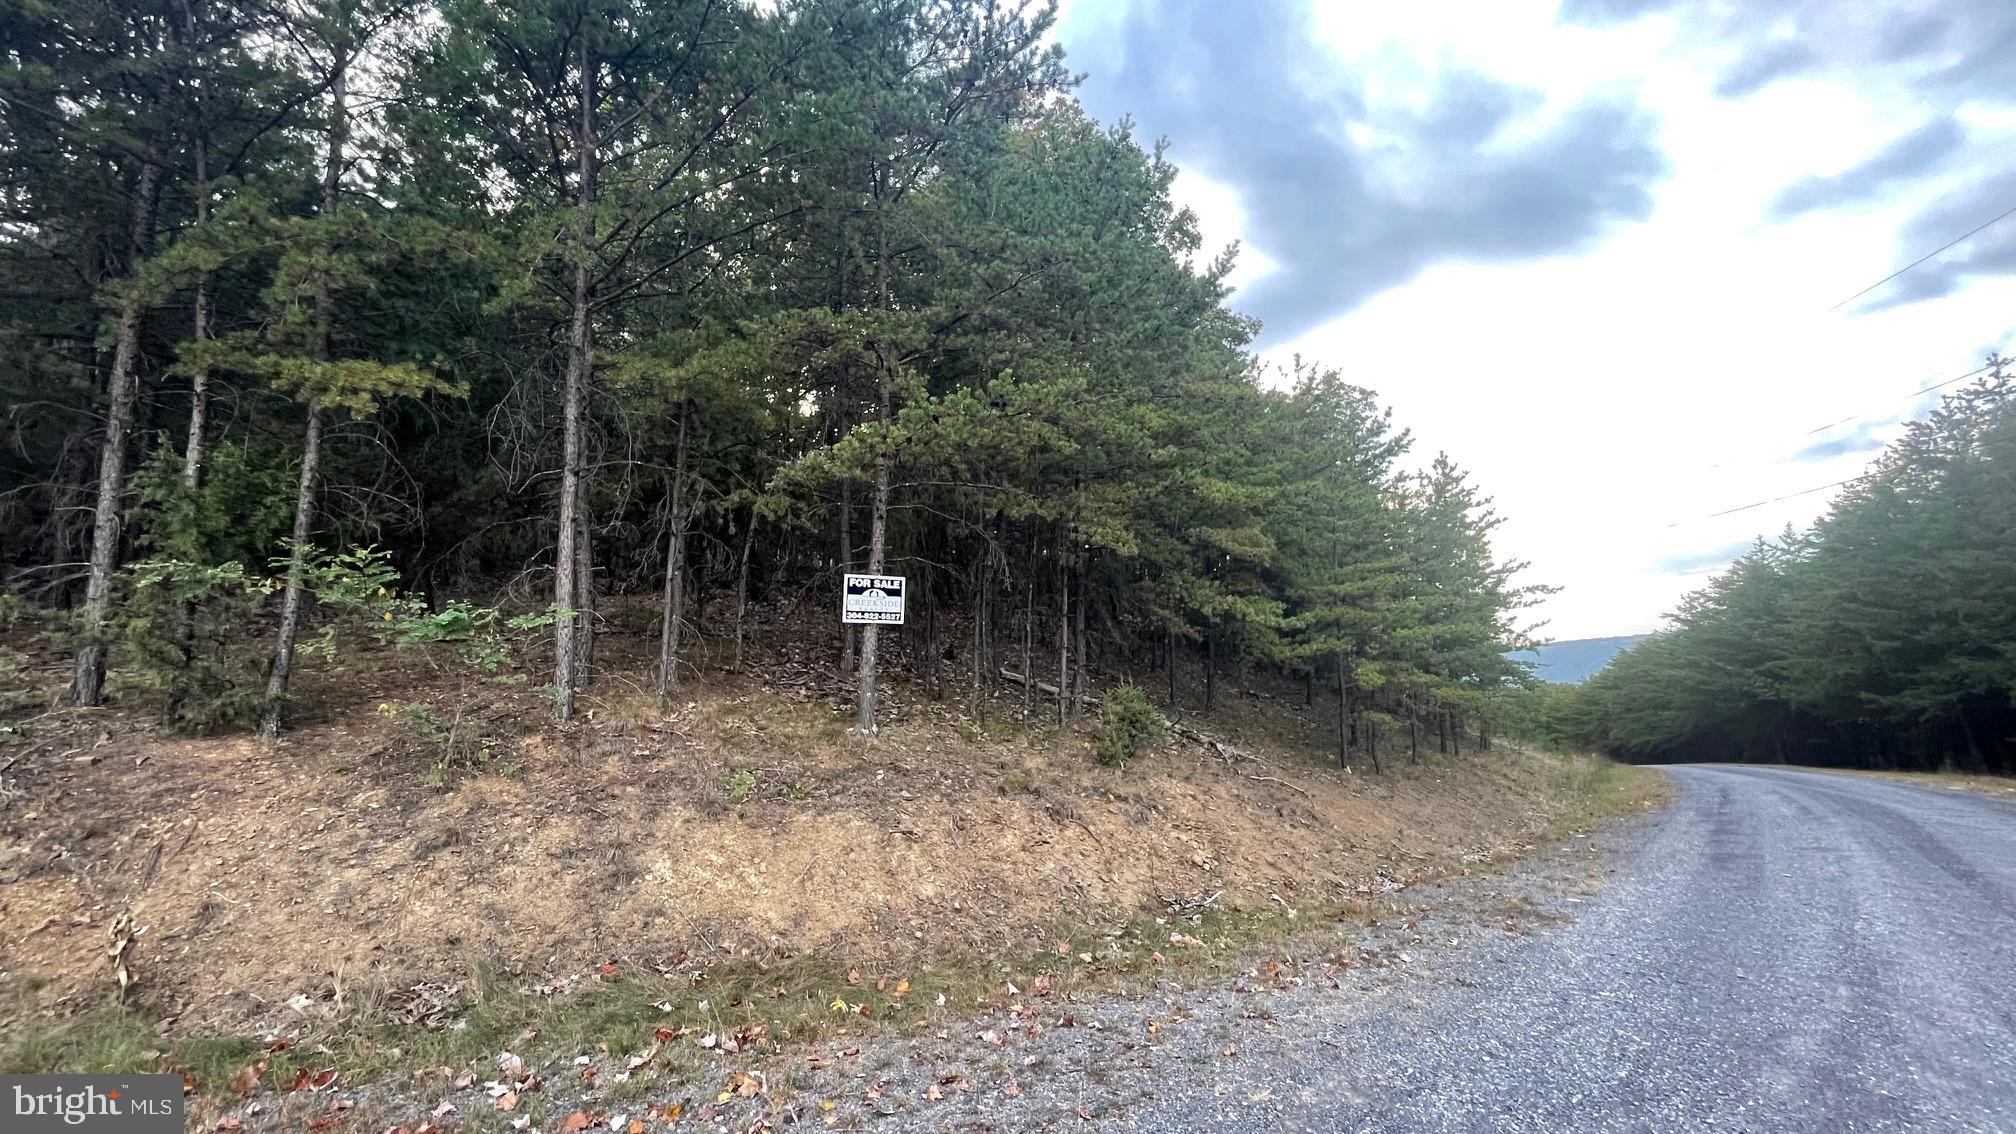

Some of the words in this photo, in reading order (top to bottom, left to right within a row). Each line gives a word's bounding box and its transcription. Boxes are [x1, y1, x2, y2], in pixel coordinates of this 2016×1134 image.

[849, 578, 871, 588] FOR
[873, 580, 901, 589] SALE
[848, 599, 900, 608] CREEKSIDE
[846, 612, 901, 620] 304-822-5527
